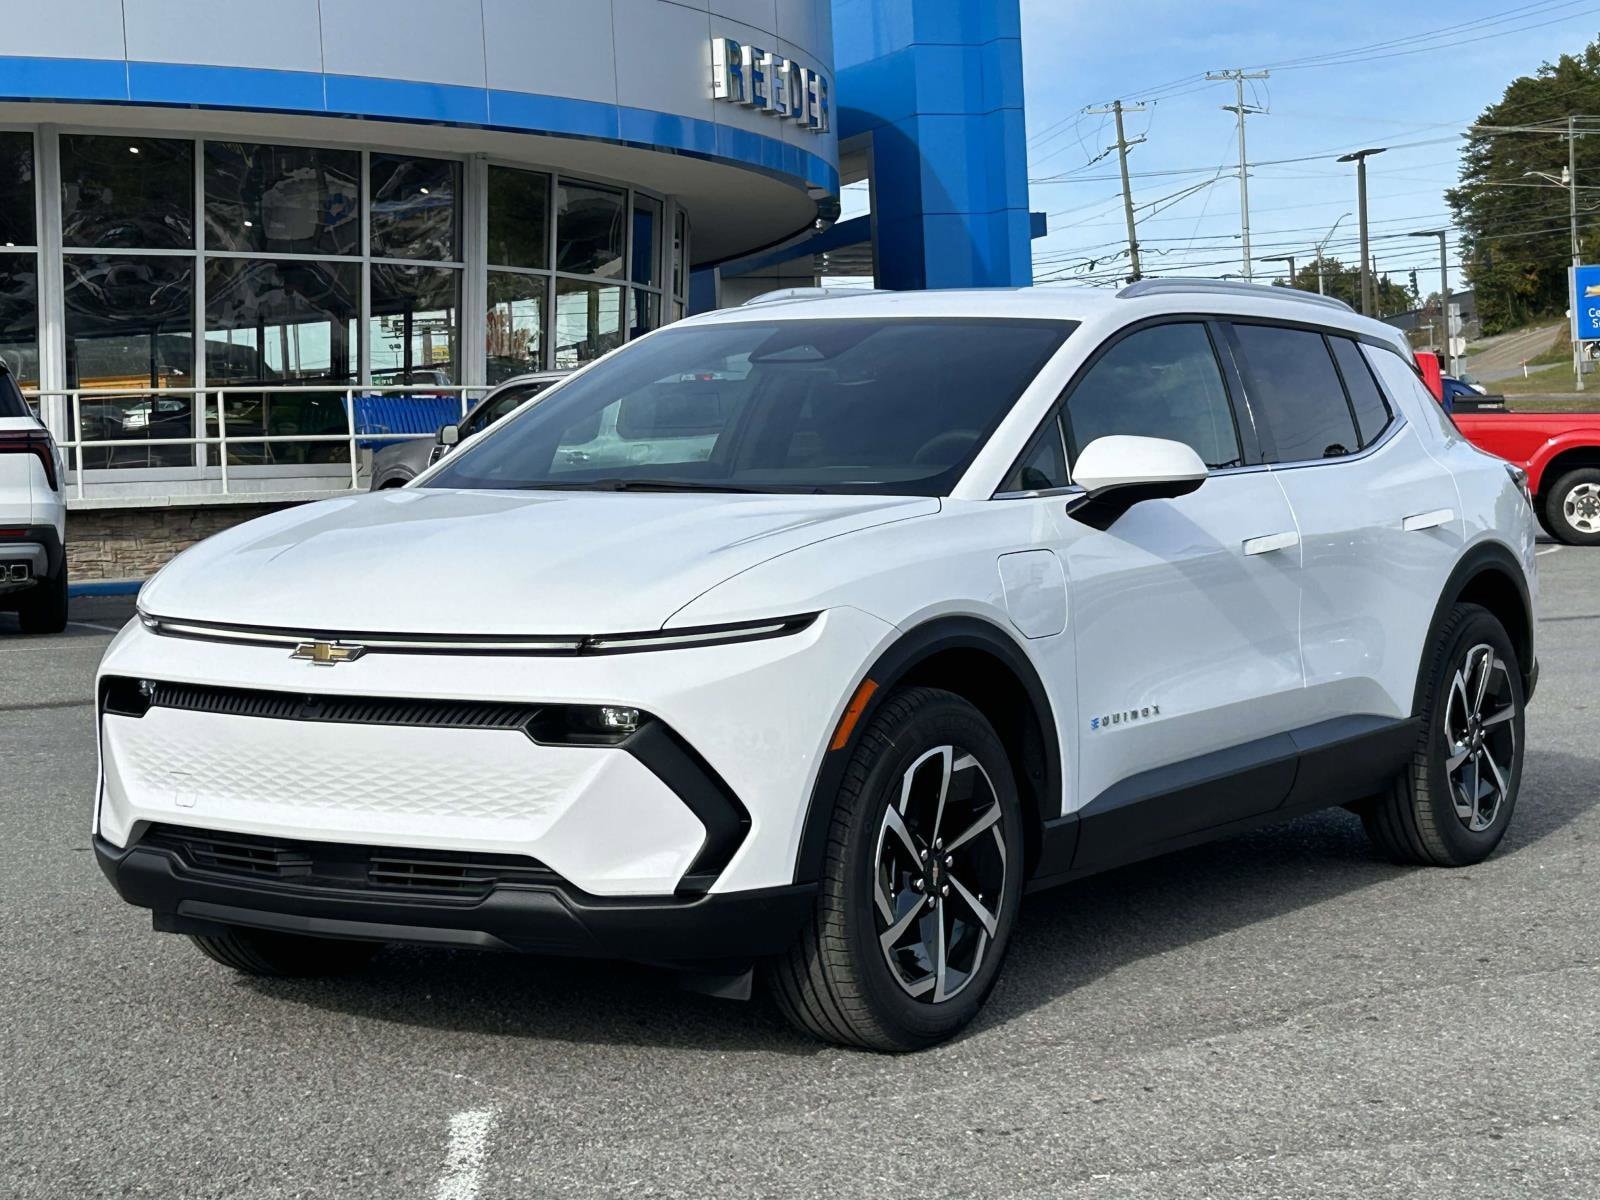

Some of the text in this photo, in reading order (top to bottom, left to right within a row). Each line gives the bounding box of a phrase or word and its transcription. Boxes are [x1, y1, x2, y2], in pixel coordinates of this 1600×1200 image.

[712, 38, 829, 133] REEDER
[1592, 318, 1600, 329] S
[1091, 704, 1160, 730] EQUINOX
